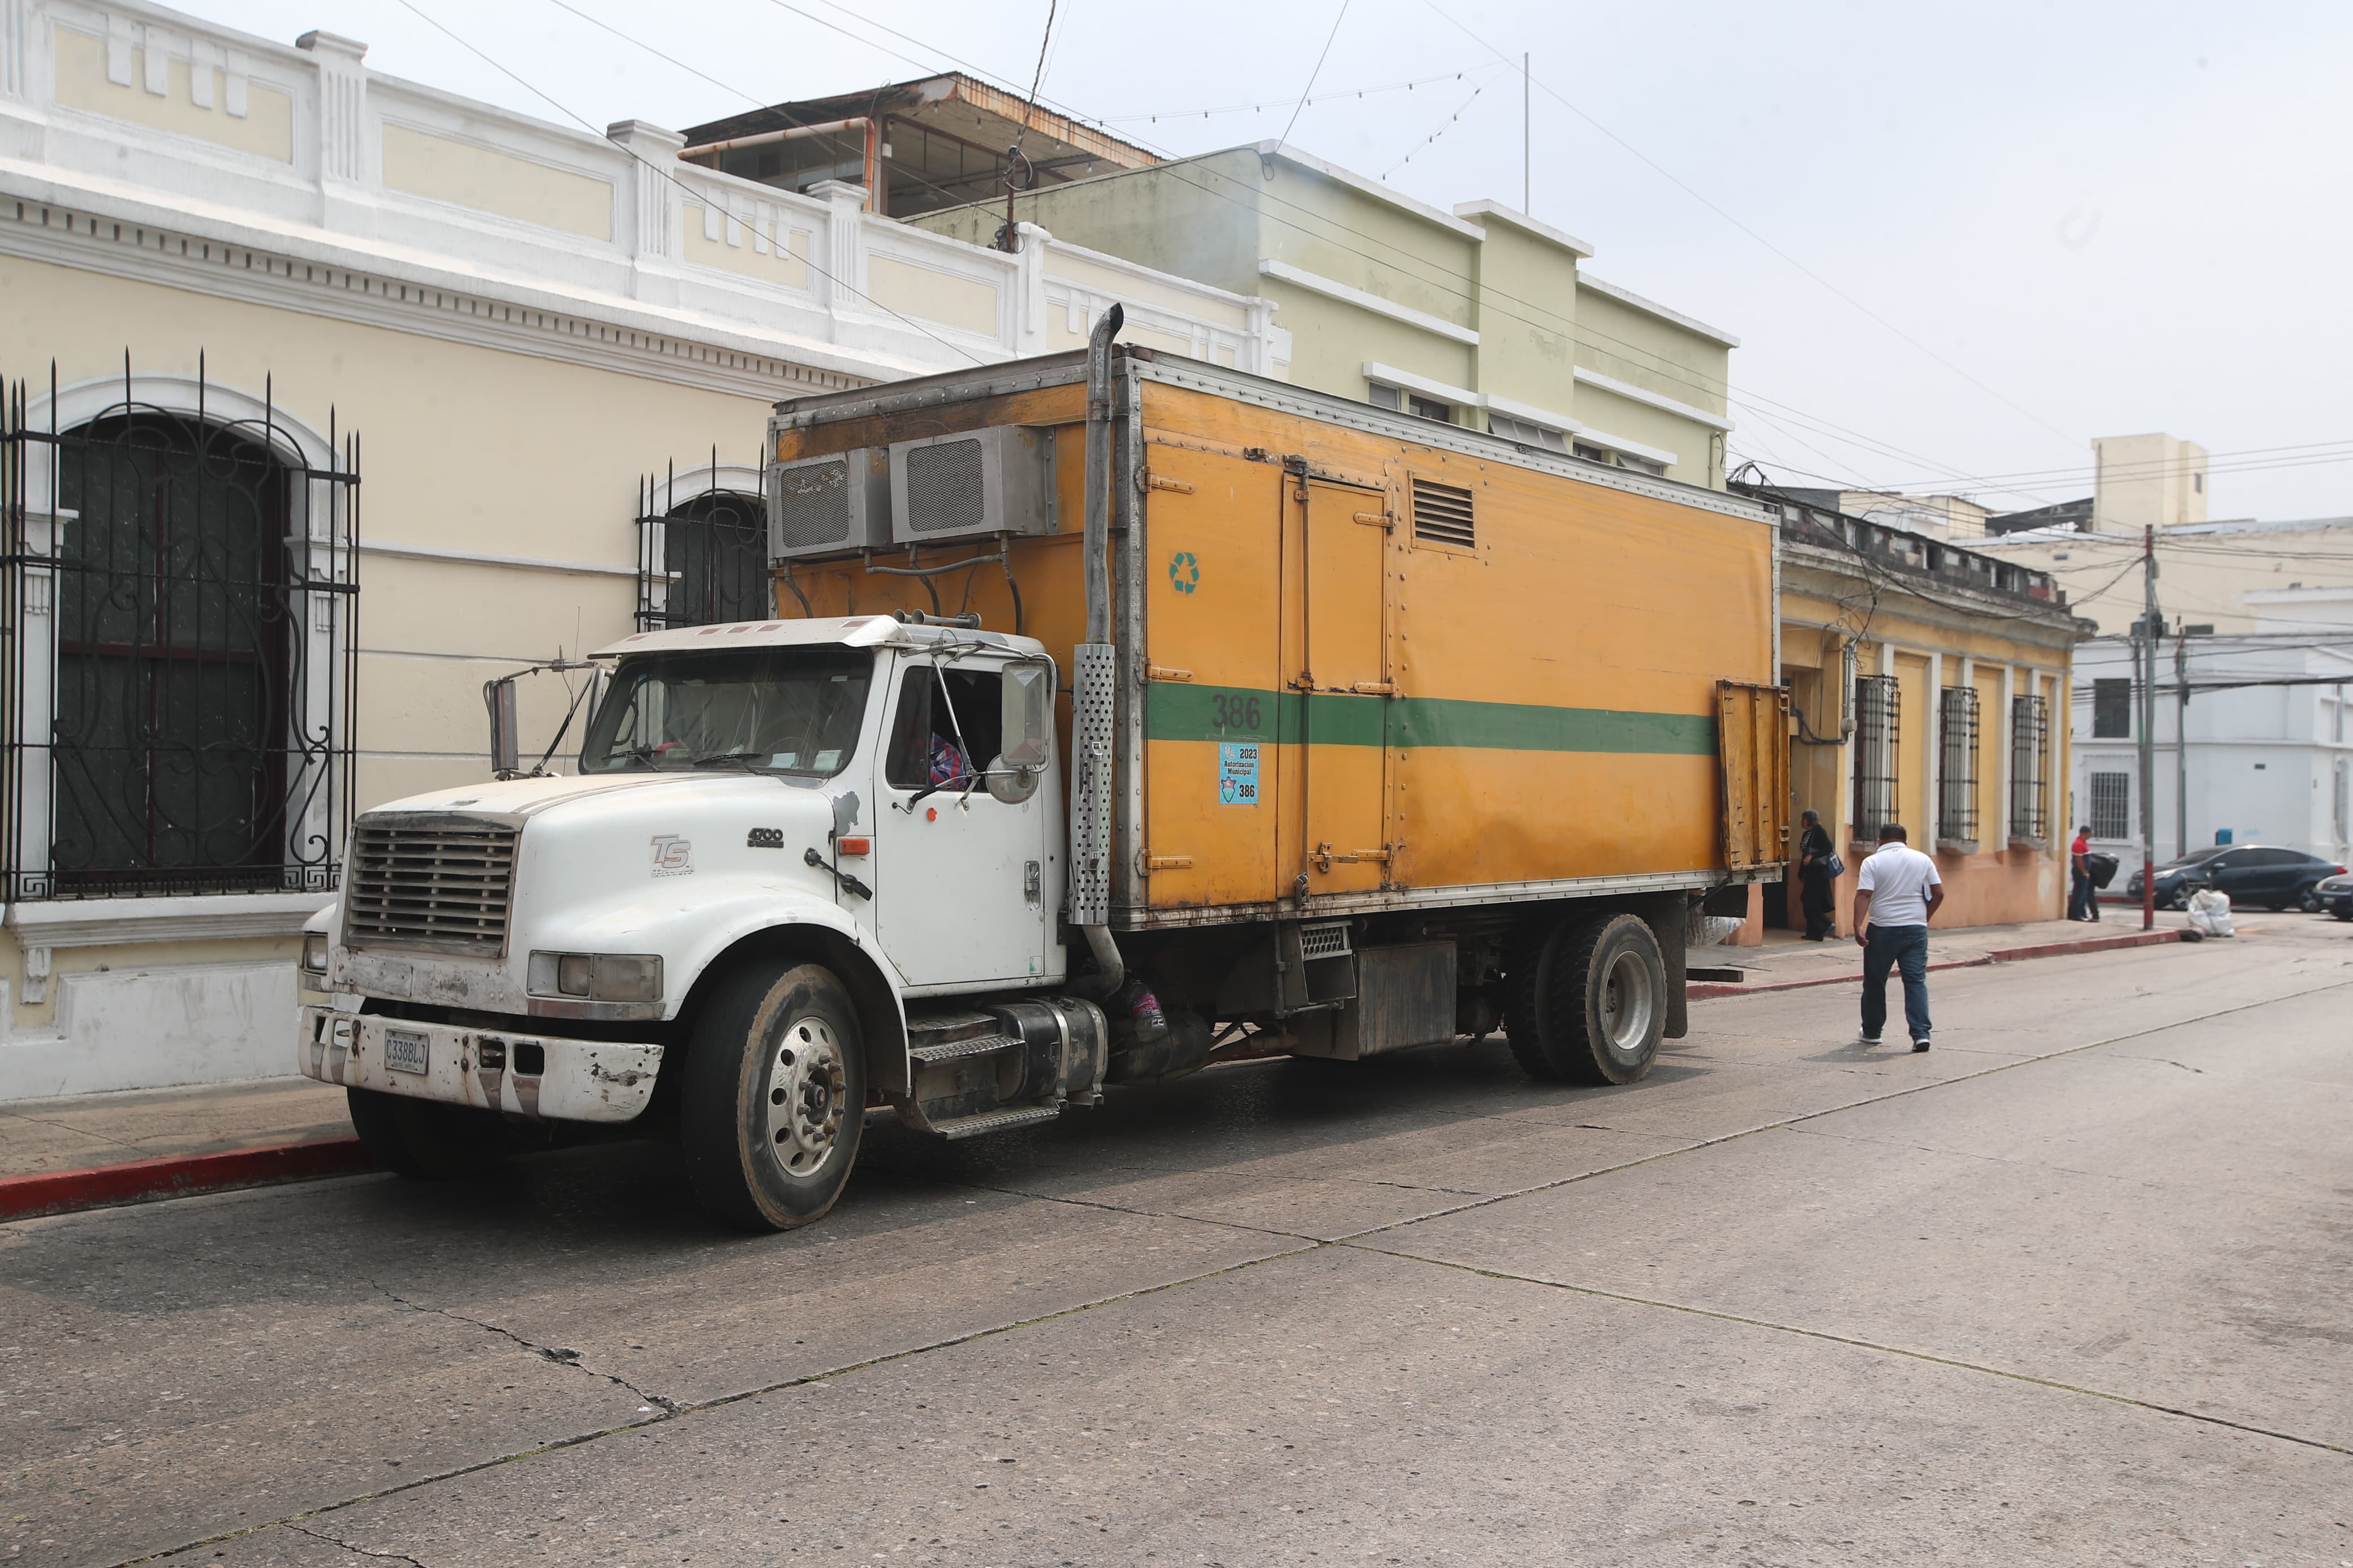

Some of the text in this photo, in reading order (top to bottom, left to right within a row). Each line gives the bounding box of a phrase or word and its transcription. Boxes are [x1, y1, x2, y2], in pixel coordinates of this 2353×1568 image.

[1212, 694, 1261, 730] 386
[1240, 748, 1257, 759] 2023
[1227, 768, 1252, 776] Municipal
[1239, 784, 1255, 797] 386
[748, 828, 783, 841] 4700
[651, 834, 691, 868] TS
[386, 1039, 425, 1064] C338BLJ
